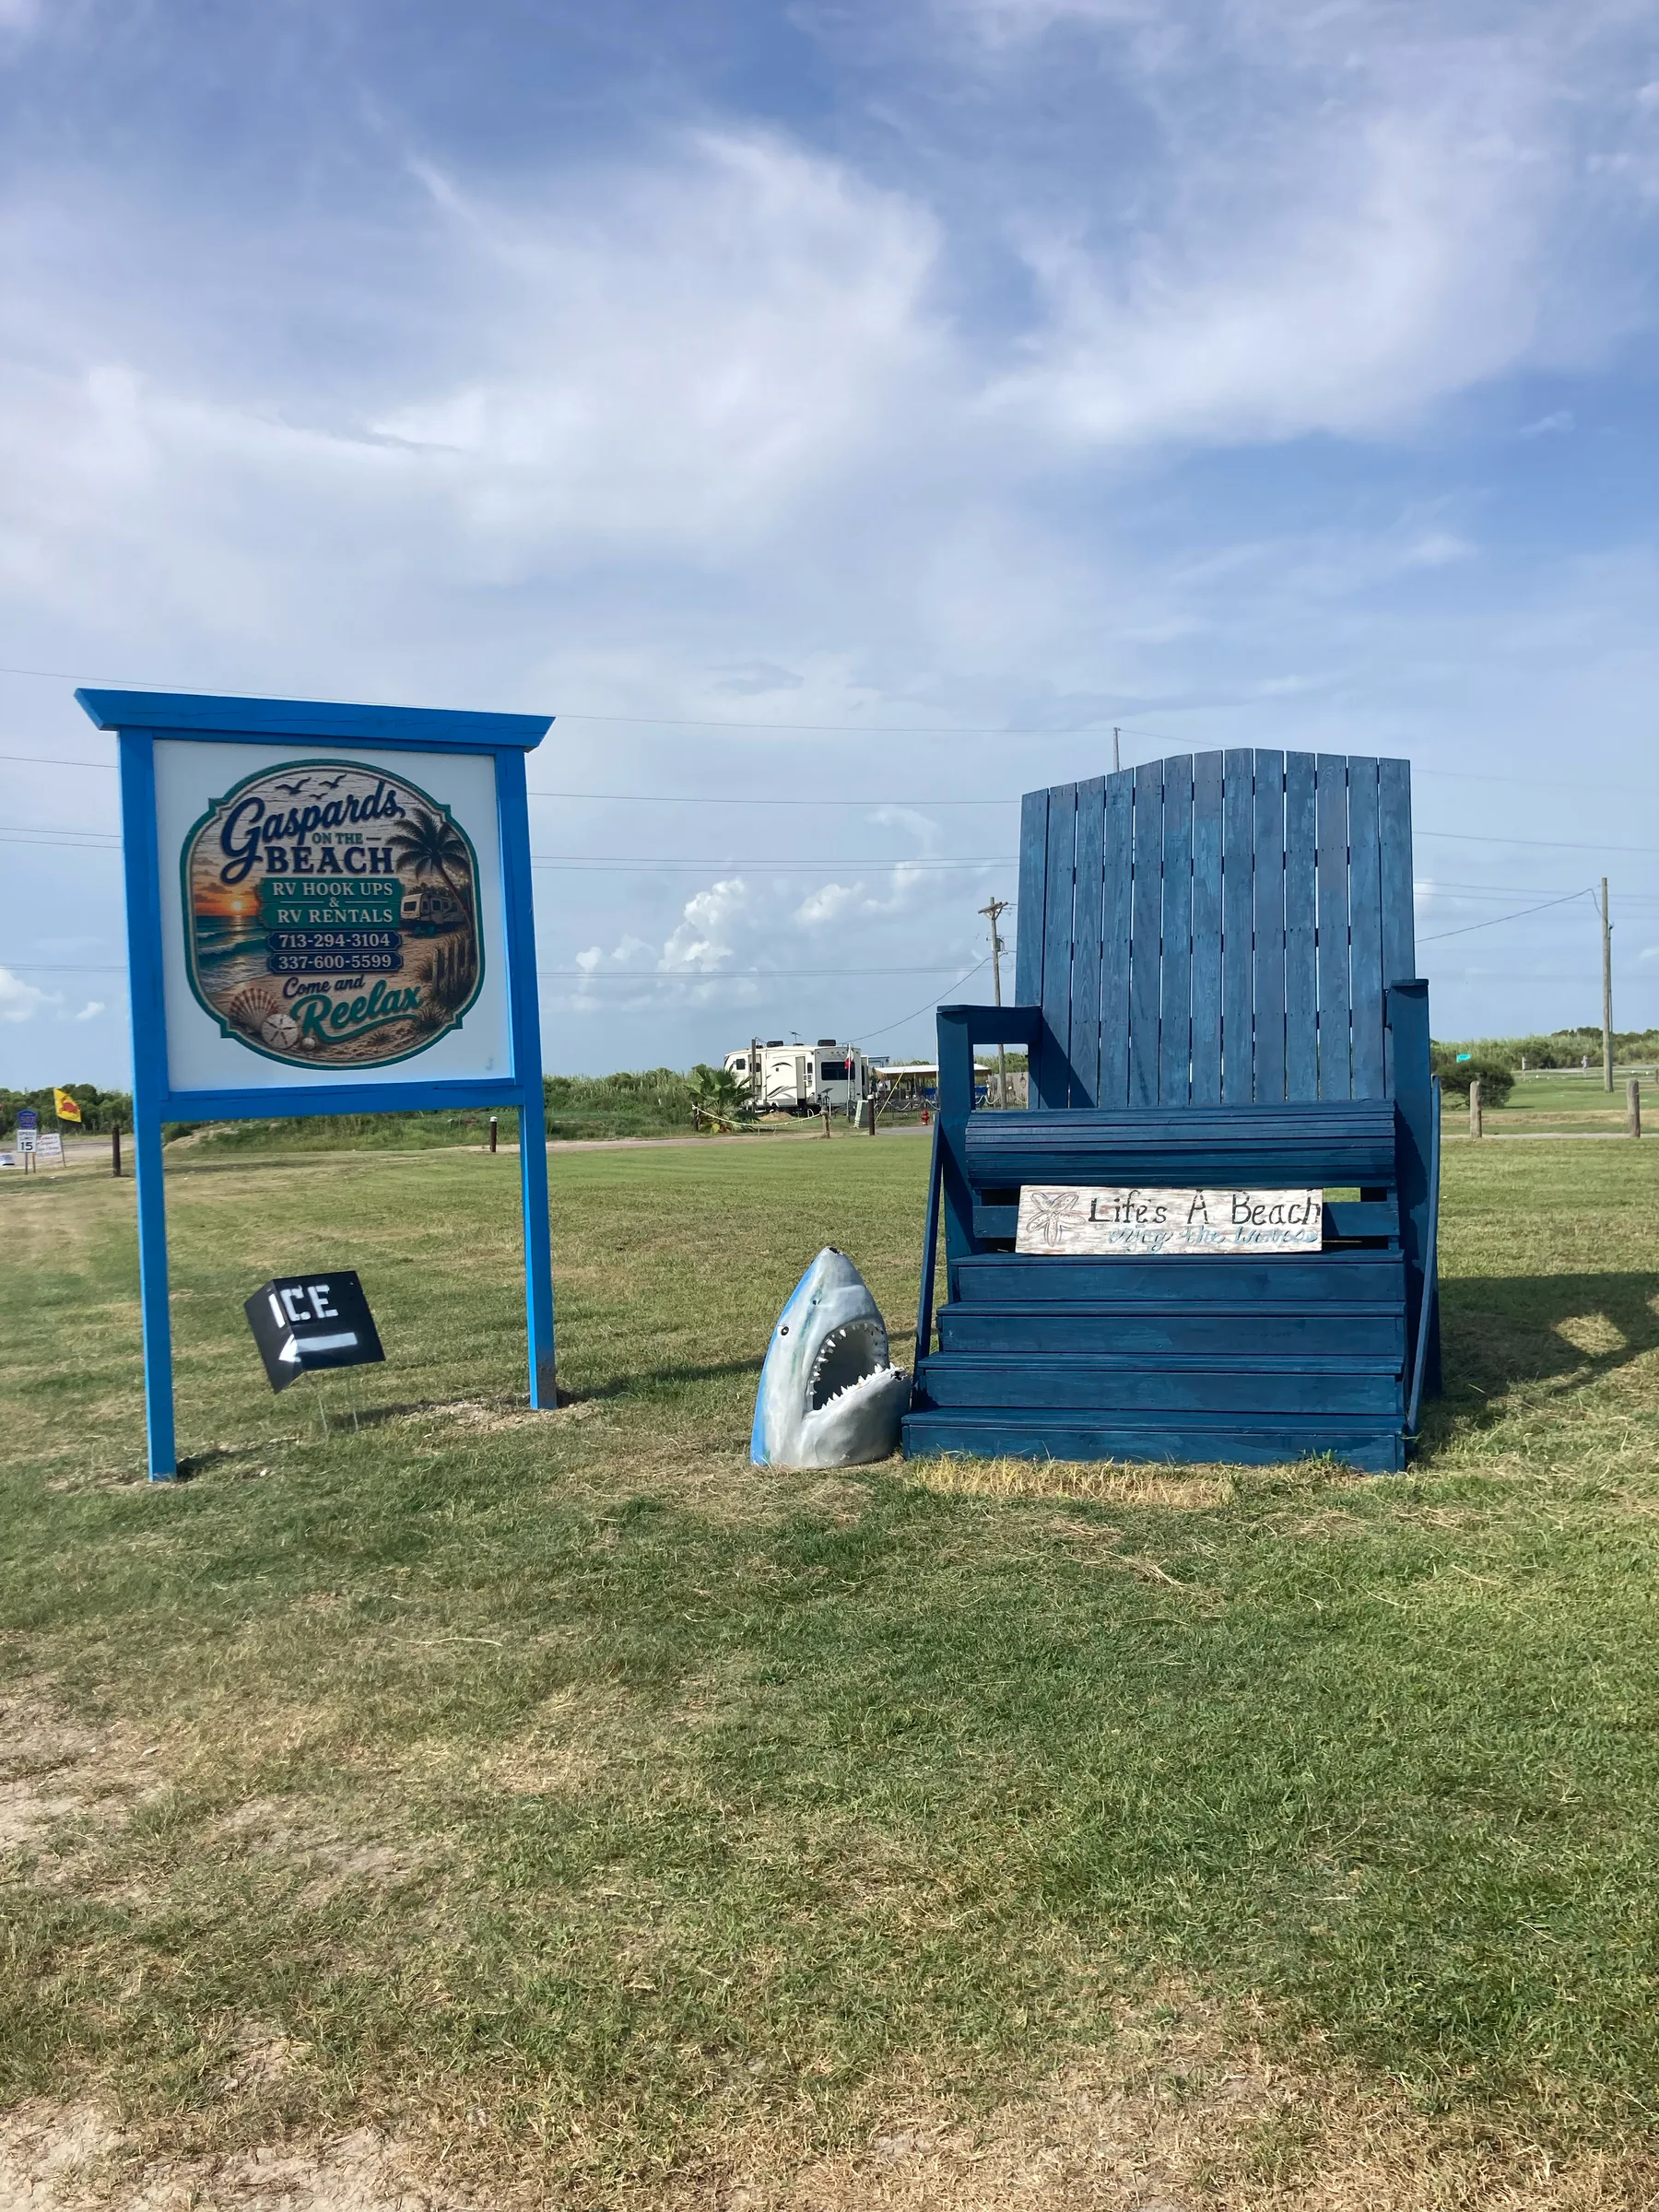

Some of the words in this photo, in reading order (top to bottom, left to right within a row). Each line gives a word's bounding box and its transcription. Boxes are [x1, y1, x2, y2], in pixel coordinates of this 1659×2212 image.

[220, 780, 406, 885] Gaspards
[312, 832, 333, 845] ON
[335, 831, 364, 844] THE
[265, 845, 395, 875] BEACH
[273, 882, 297, 896] RV
[302, 882, 354, 897] HOOK
[359, 882, 394, 896] UPS
[328, 897, 340, 908] &
[277, 909, 302, 924] RV
[309, 908, 394, 923] RENTALS
[278, 933, 391, 948] 713-294-3104
[278, 953, 393, 969] 337-600-5599
[282, 976, 331, 999] Come
[334, 974, 366, 991] and
[289, 979, 424, 1042] Reelax
[20, 1141, 33, 1151] 15
[1088, 1189, 1168, 1225] Life's
[1187, 1189, 1210, 1225] A
[1231, 1188, 1322, 1226] Beach
[268, 1285, 339, 1328] ICE
